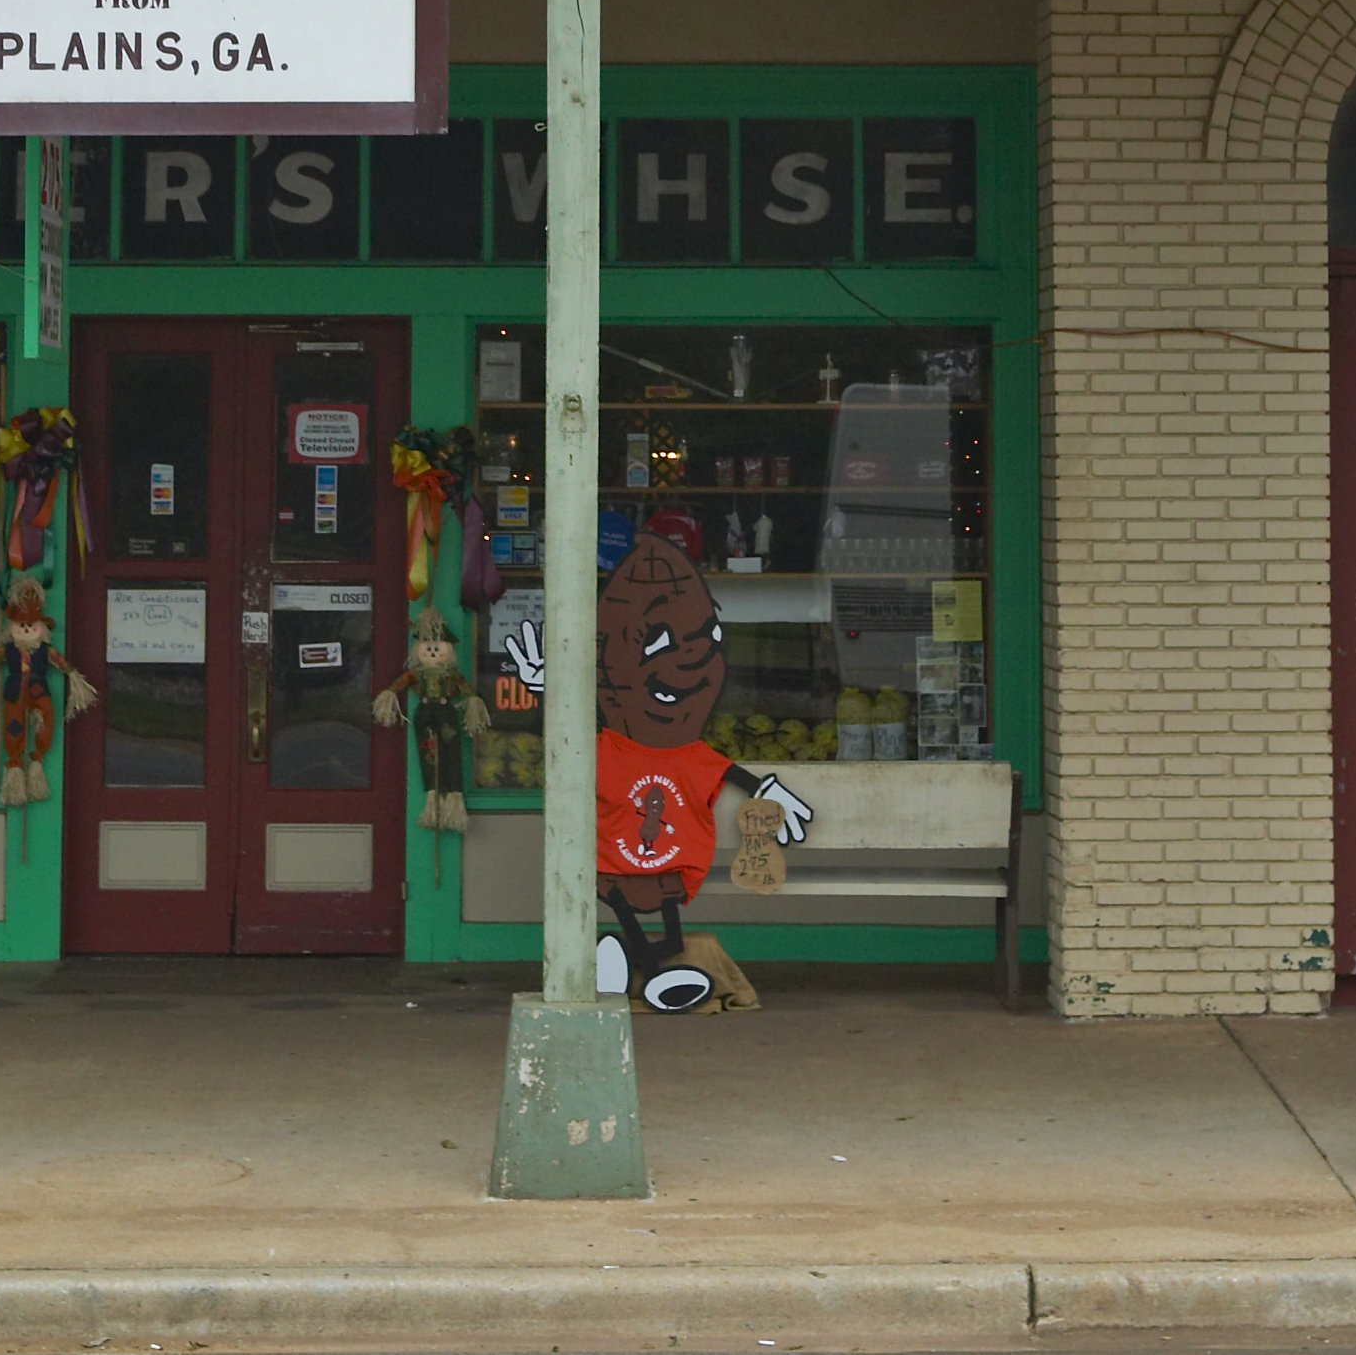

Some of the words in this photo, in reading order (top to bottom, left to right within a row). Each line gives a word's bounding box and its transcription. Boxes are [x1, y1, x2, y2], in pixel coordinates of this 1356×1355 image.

[212, 32, 289, 72] GA.
[299, 436, 327, 444] Closed
[328, 436, 355, 444] Circuit
[299, 443, 355, 453] Television
[330, 593, 370, 605] CLOSED
[243, 615, 267, 630] Push
[653, 775, 678, 794] NUTS
[674, 793, 686, 807] IN
[744, 804, 781, 831] Fried
[641, 845, 681, 869] GEORGIA
